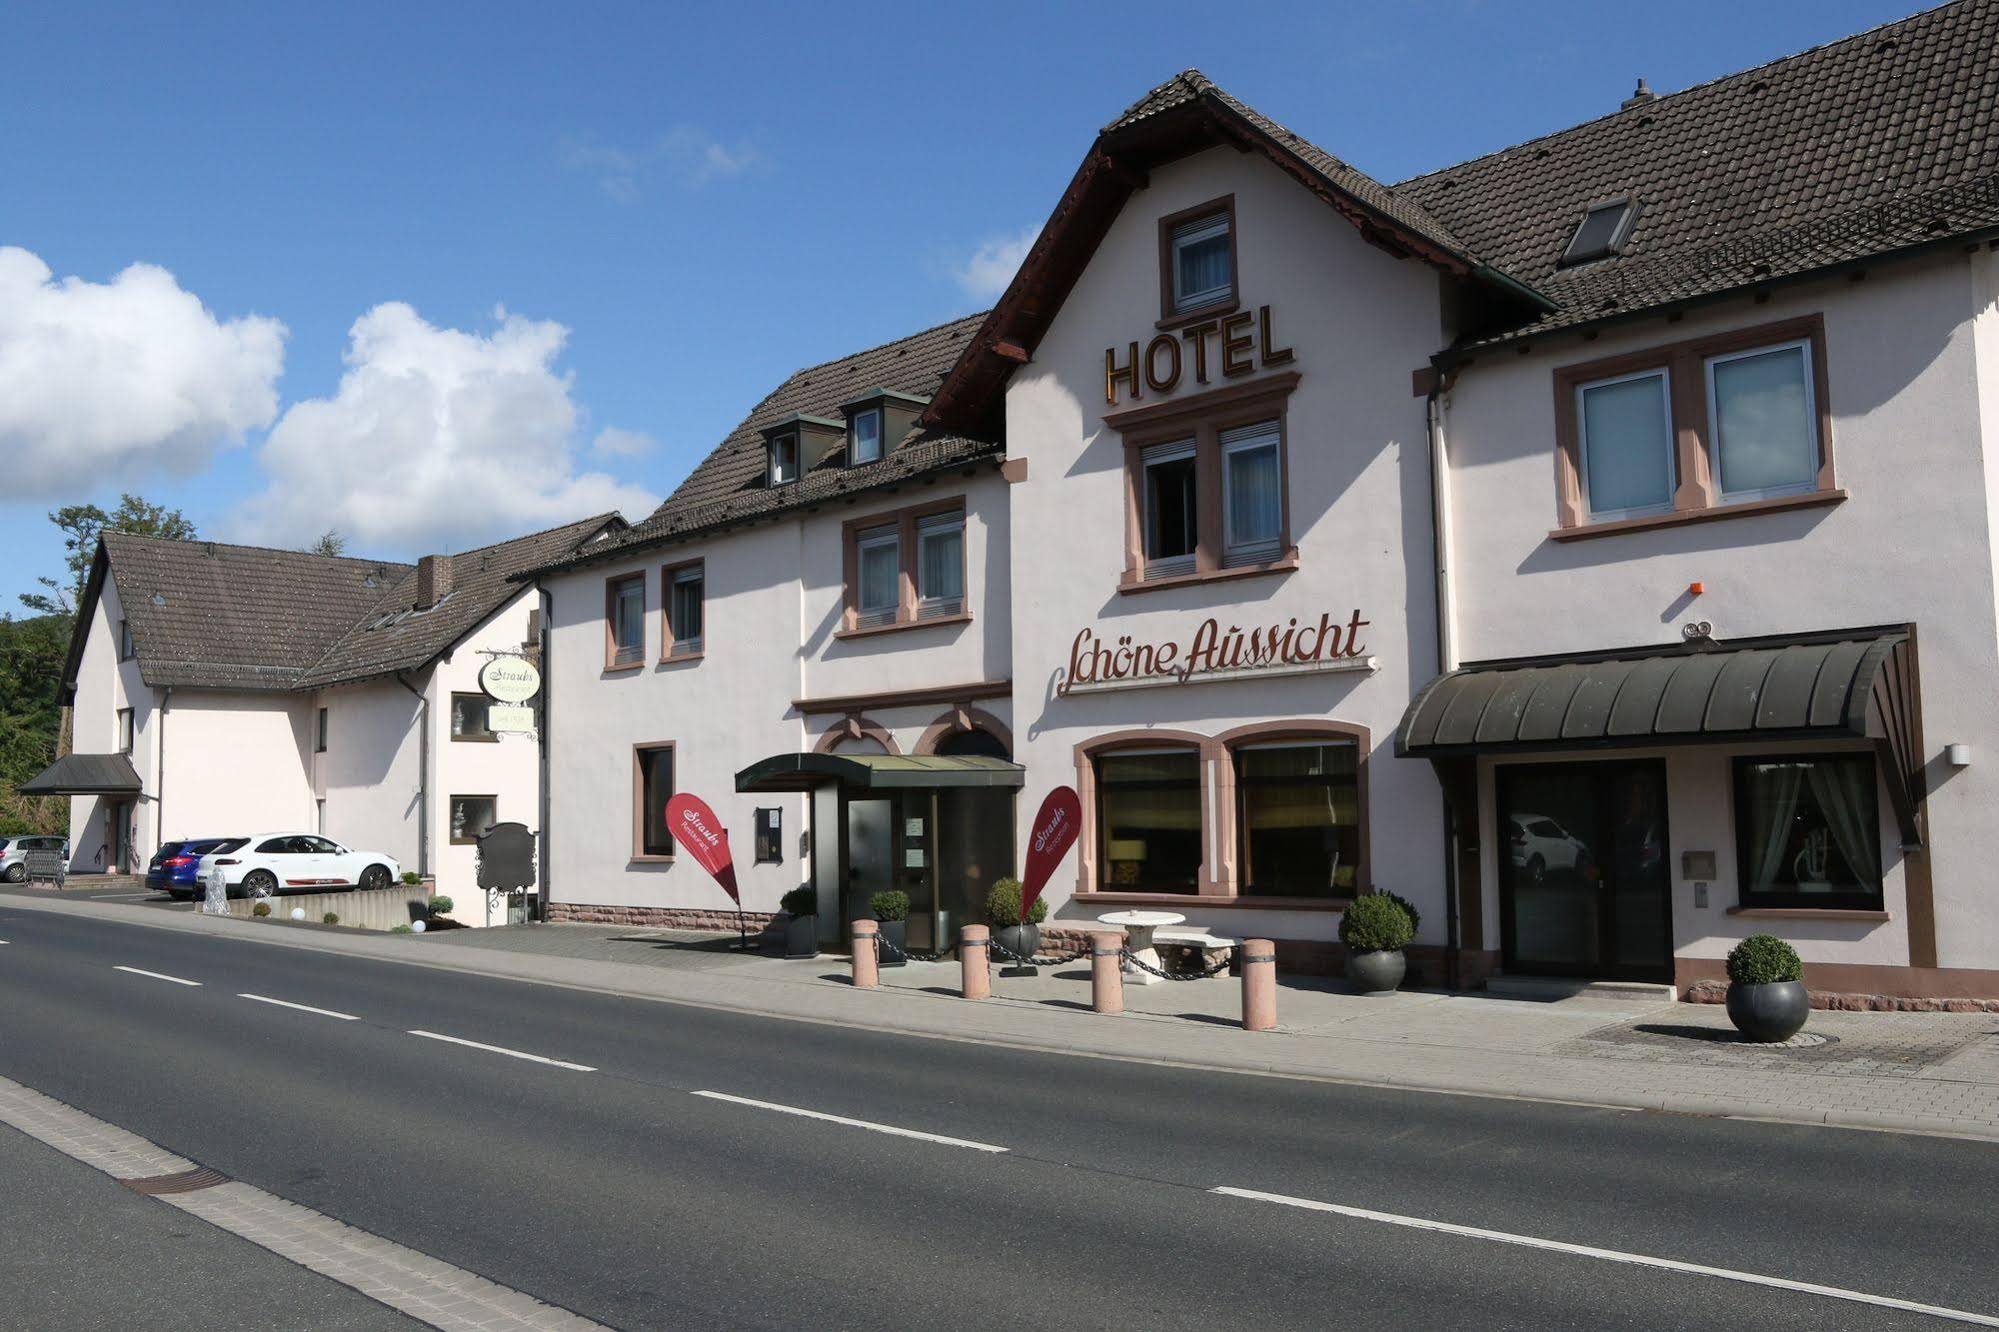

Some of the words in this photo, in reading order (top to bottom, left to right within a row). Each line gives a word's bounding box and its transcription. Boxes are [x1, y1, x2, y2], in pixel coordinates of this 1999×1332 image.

[1105, 305, 1294, 404] HOTEL
[490, 668, 533, 682] Straubs
[1056, 627, 1178, 697] Schöne
[683, 809, 719, 846] Straubs
[1035, 808, 1065, 851] Straubs
